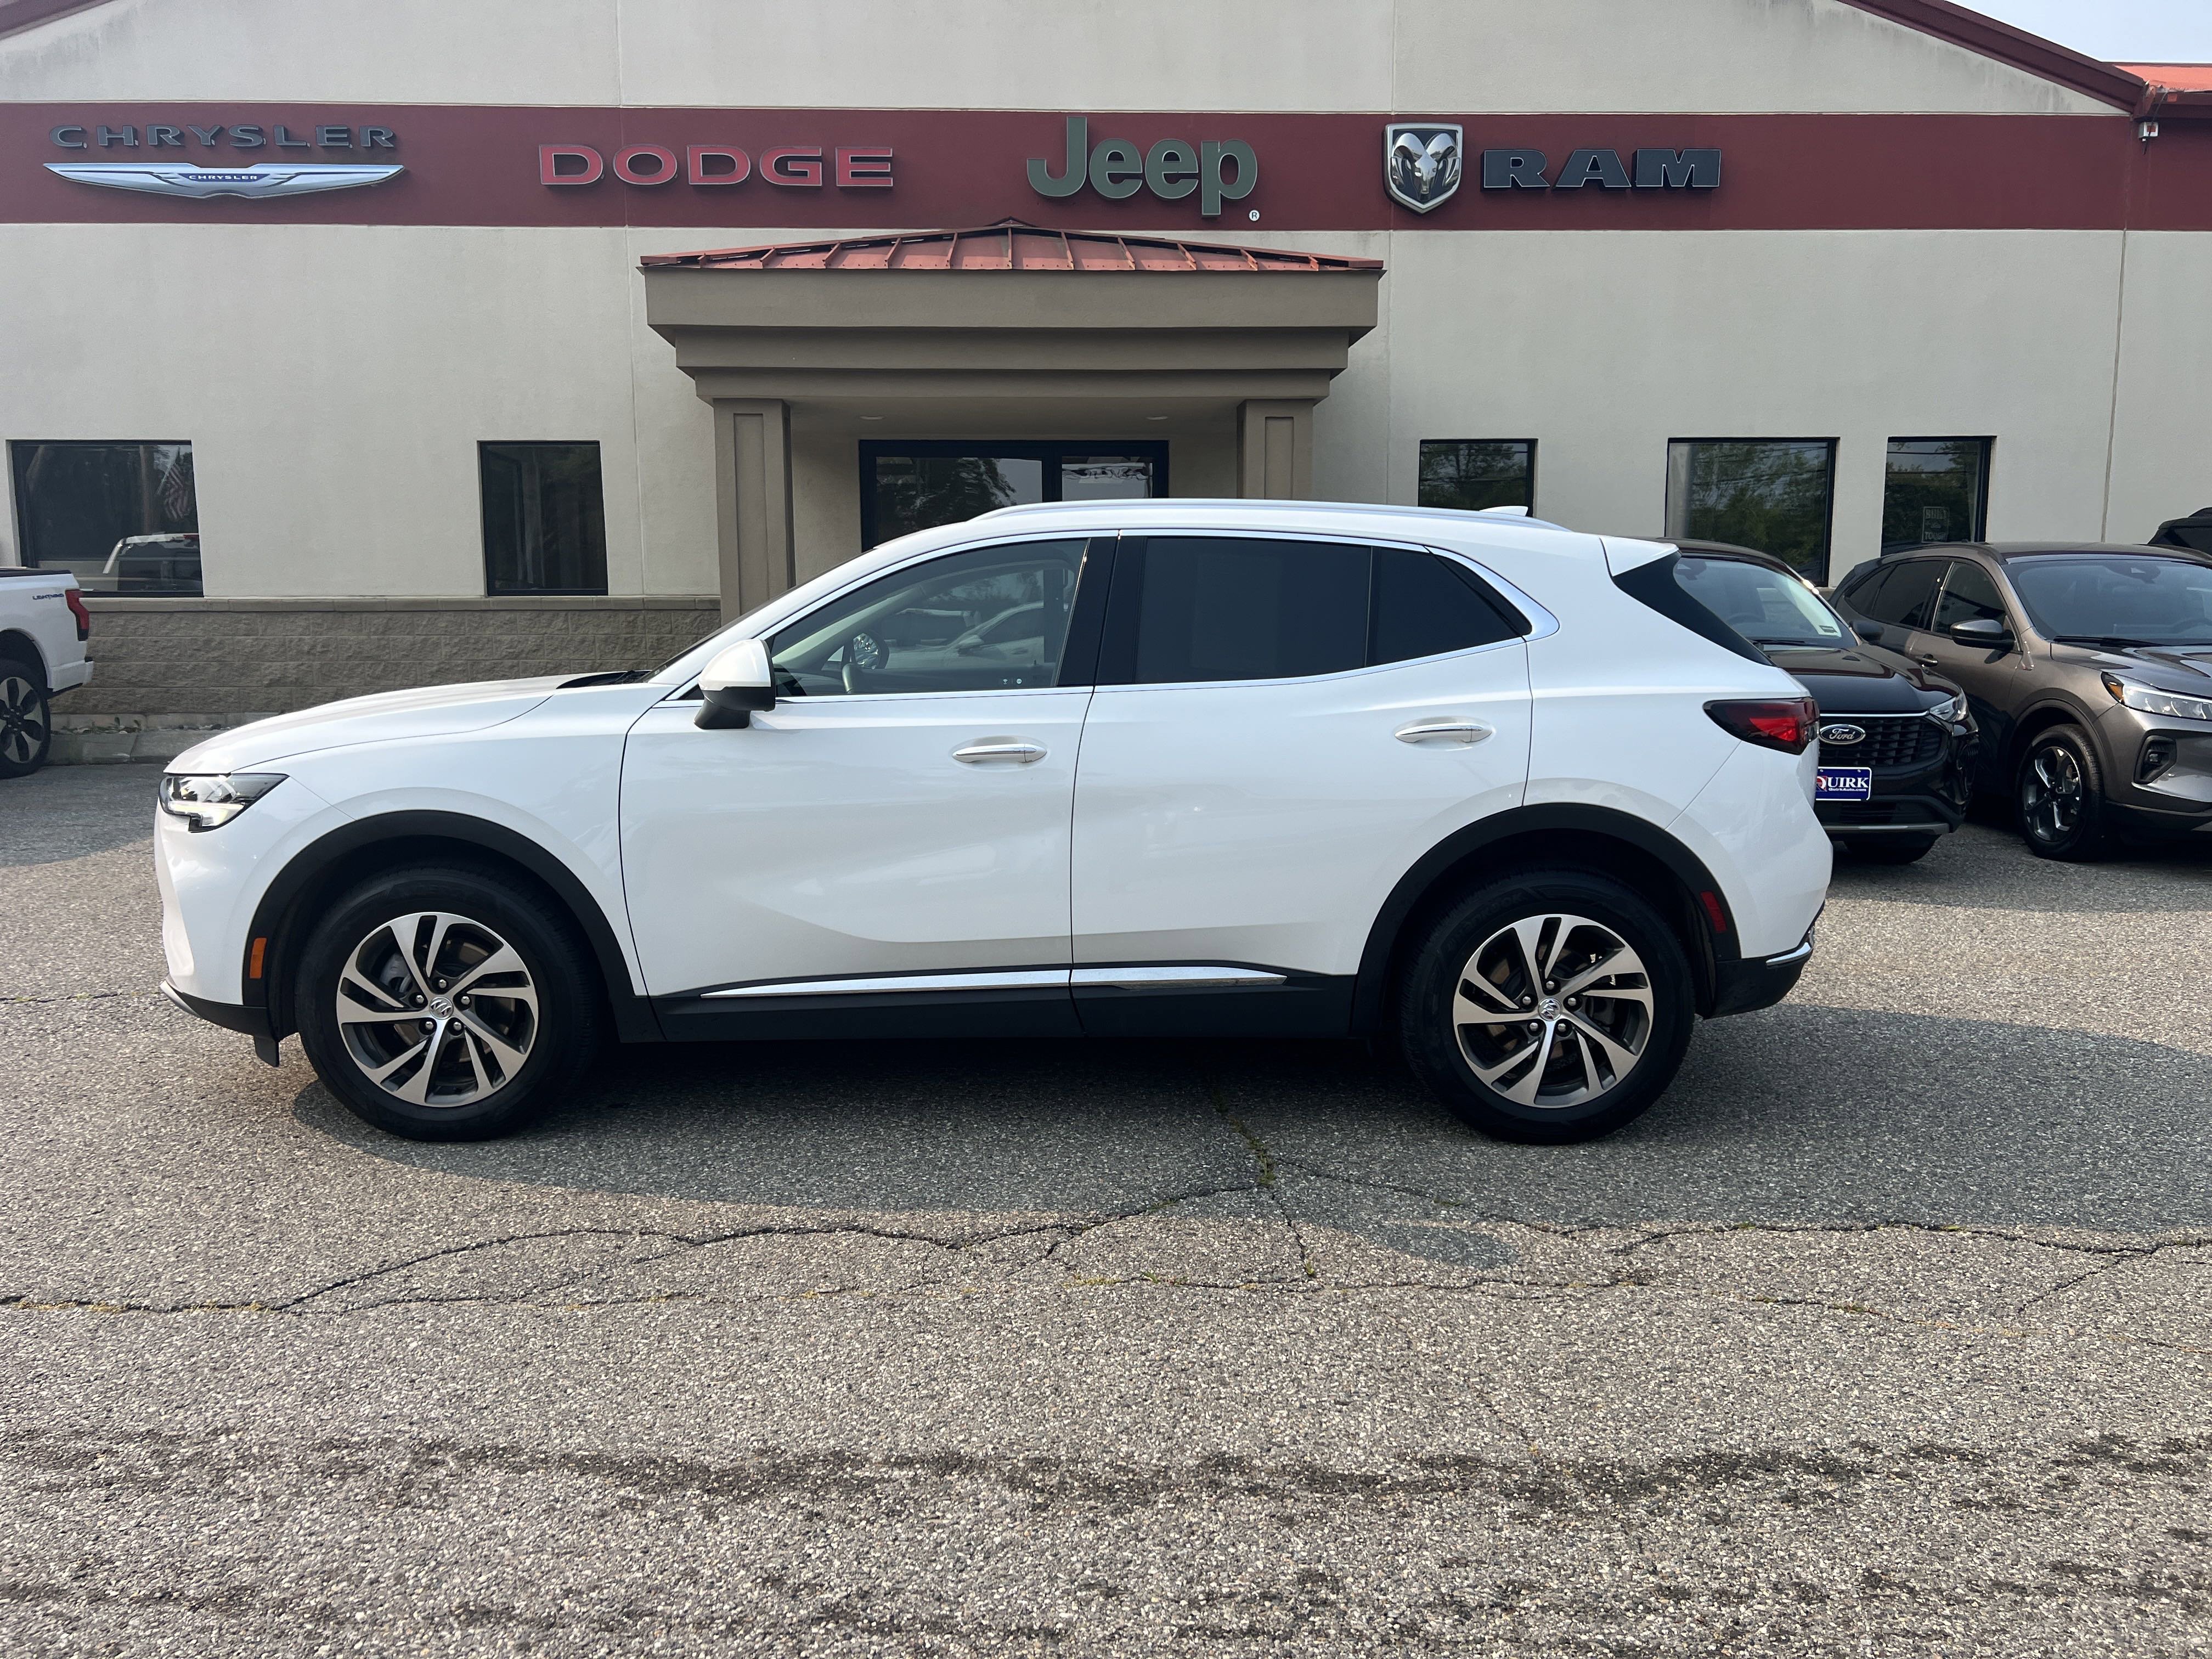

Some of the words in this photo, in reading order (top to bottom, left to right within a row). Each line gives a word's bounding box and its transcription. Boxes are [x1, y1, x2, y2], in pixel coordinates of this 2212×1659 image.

[50, 125, 396, 148] CHRYSLER
[539, 144, 894, 187] DODGE
[1027, 116, 1258, 216] Jeep
[1482, 149, 1722, 189] RAM
[1829, 728, 1855, 740] Ford
